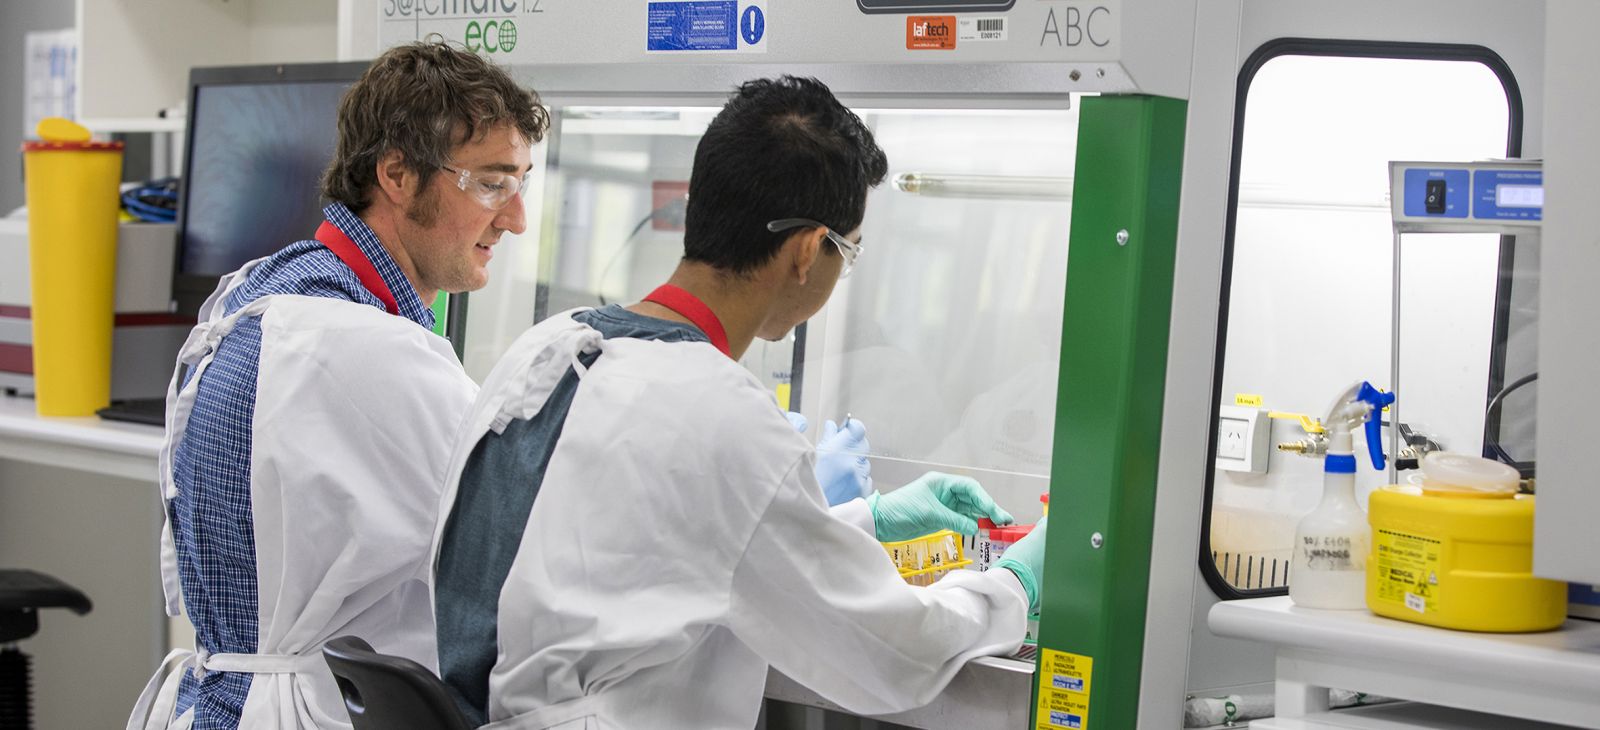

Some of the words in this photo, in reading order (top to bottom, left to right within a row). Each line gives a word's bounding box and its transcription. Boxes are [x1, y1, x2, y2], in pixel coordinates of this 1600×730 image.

[464, 20, 518, 53] eco
[913, 22, 949, 37] laftech
[1040, 6, 1110, 47] ABC
